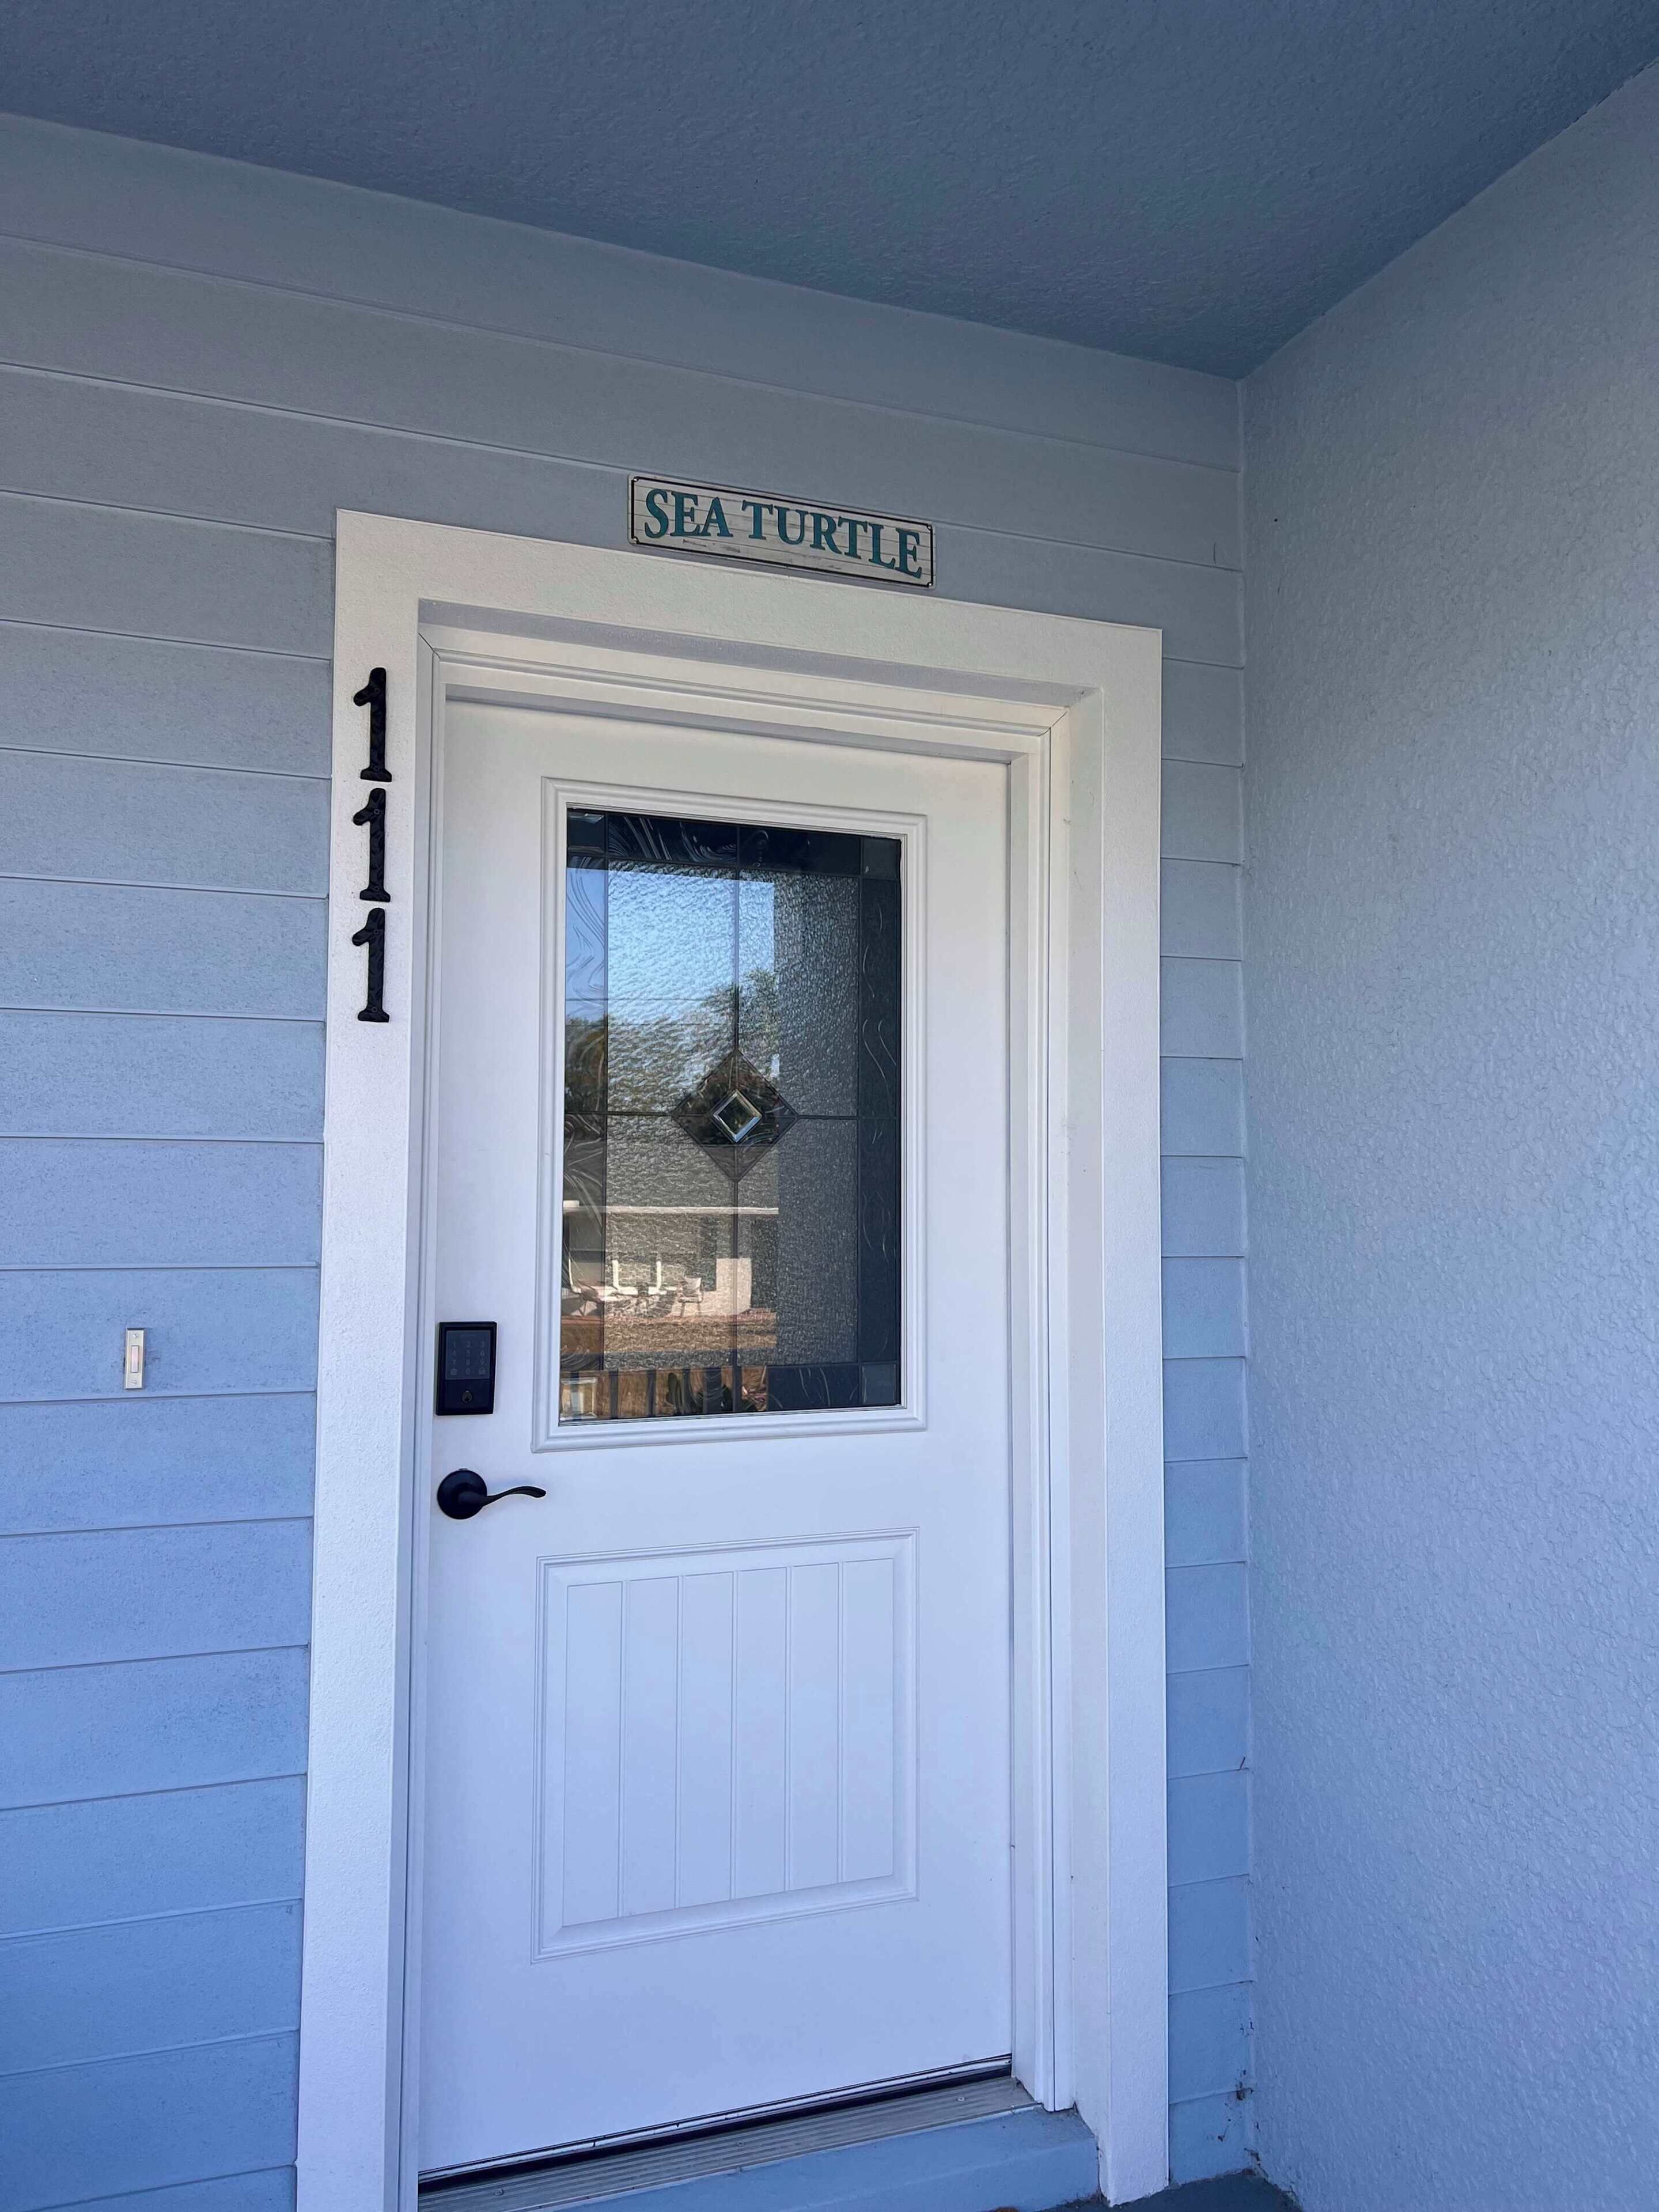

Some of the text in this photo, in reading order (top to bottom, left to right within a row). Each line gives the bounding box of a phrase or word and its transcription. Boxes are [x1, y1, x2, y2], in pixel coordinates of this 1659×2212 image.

[644, 488, 922, 579] SEA TURTLE
[352, 667, 392, 1022] 111
